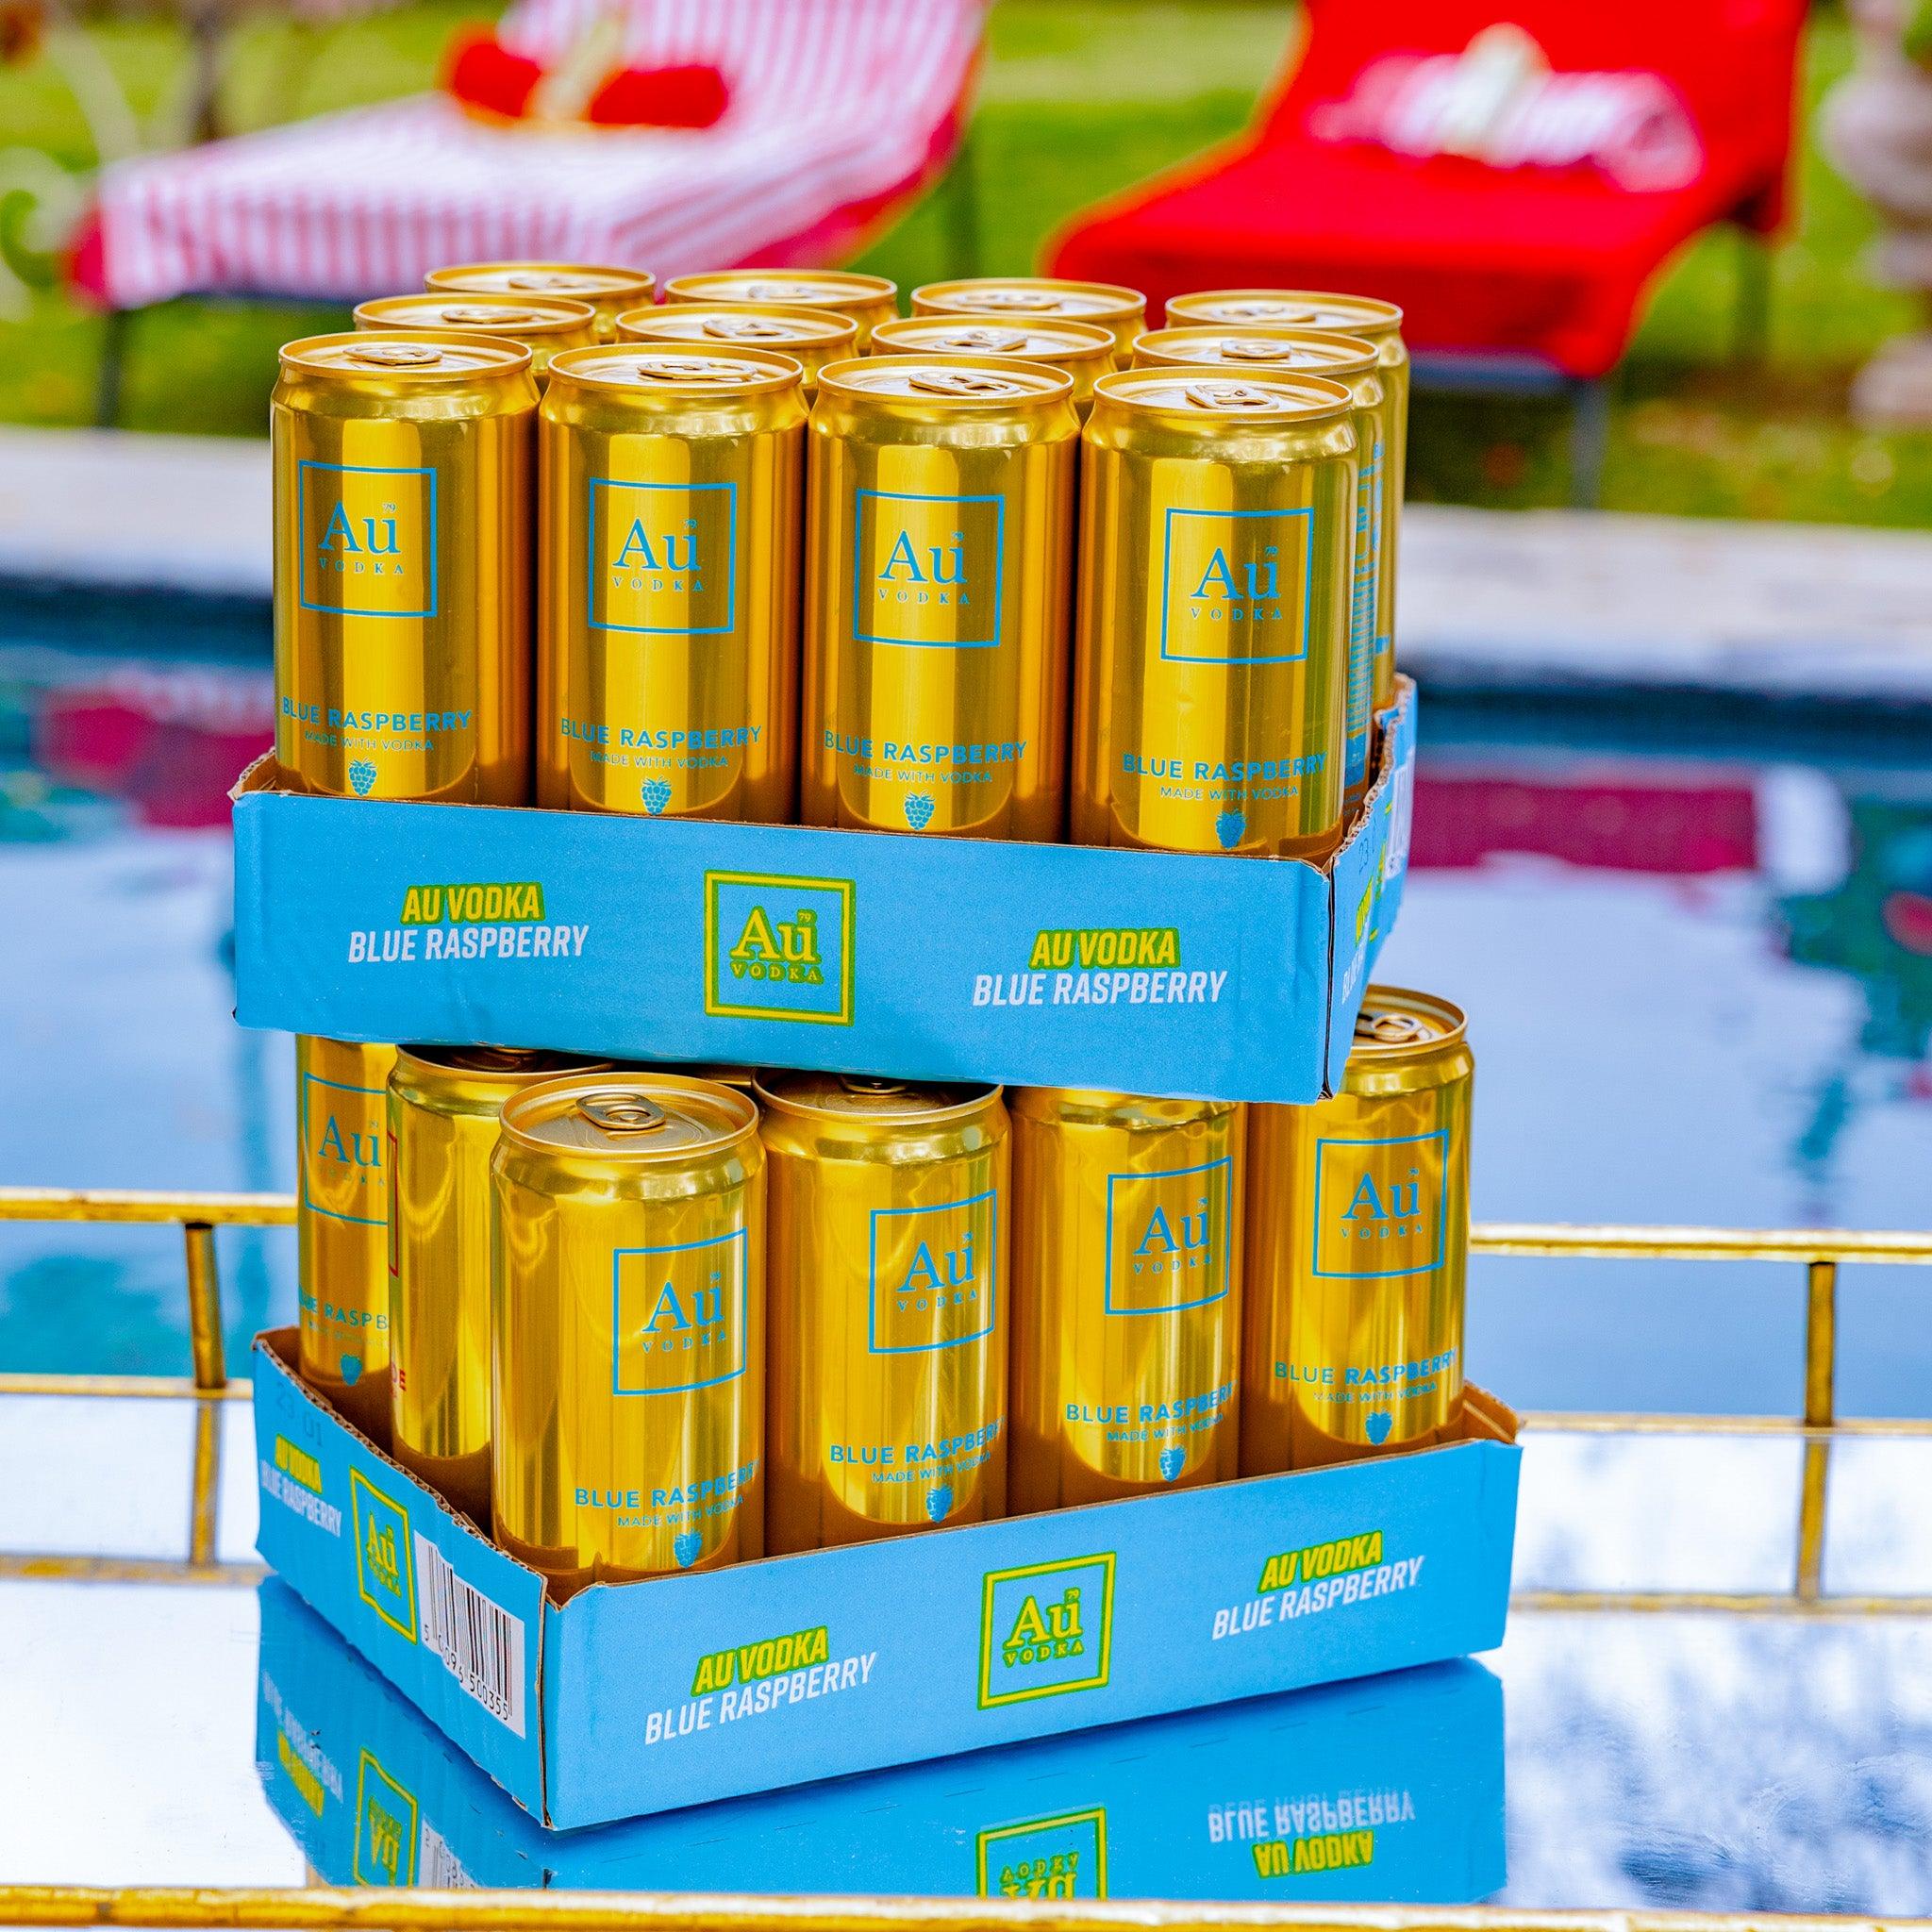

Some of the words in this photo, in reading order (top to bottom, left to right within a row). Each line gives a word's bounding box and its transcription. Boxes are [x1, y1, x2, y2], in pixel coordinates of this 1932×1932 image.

[319, 501, 402, 555] Au
[612, 516, 701, 572] Au
[319, 558, 404, 574] VODKA
[878, 529, 967, 584] Au
[613, 576, 705, 591] VODKA
[1190, 547, 1281, 600] Au
[878, 589, 970, 605] VODKA
[1191, 608, 1283, 621] VODKA
[282, 696, 320, 724] BLUE
[328, 709, 472, 732] RASPBERRY
[305, 730, 337, 747] MADE
[341, 737, 376, 749] WITH
[381, 739, 434, 751] VODKA
[560, 718, 609, 744] BLUE
[621, 725, 762, 749] RASPBERRY
[824, 730, 873, 758] BLUE
[883, 741, 1027, 764] RASPBERRY
[591, 751, 628, 766] MADE
[634, 755, 672, 768] WITH
[677, 756, 728, 769] VODKA
[853, 764, 892, 780] MADE
[898, 770, 935, 782] WITH
[941, 771, 992, 784] VODKA
[1122, 754, 1183, 780] BLUE
[1194, 752, 1327, 782] RASPBERRY
[1159, 785, 1203, 800] MADE
[1209, 786, 1246, 800] WITH
[1252, 785, 1299, 800] VODKA
[402, 887, 441, 924] AU
[447, 884, 542, 923] VODKA
[348, 930, 418, 962] BLUE
[425, 924, 589, 960] RASPBERRY
[730, 908, 820, 962] Au
[1029, 931, 1074, 968] AU
[1078, 928, 1179, 968] VODKA
[731, 962, 822, 983] VODKA
[973, 974, 1047, 1007] BLUE
[1053, 971, 1227, 1005] RASPBERRY
[319, 1115, 381, 1168] Au
[1341, 1172, 1421, 1221] Au
[1133, 1205, 1211, 1255] Au
[1341, 1224, 1424, 1240] VODKA
[896, 1241, 974, 1291] Au
[1133, 1257, 1212, 1275] VODKA
[324, 1304, 388, 1329] RASPB
[641, 1281, 724, 1333] Au
[897, 1290, 977, 1312] VODKA
[642, 1330, 727, 1354] VODKA
[1274, 1361, 1334, 1385] BLUE
[1065, 1404, 1128, 1424] BLUE
[1140, 1379, 1238, 1424] RASPBERR
[1359, 1389, 1393, 1403] WITH
[830, 1444, 894, 1464] BLUE
[905, 1415, 1006, 1463] RASPBER
[1108, 1430, 1149, 1442] MADE
[1153, 1424, 1187, 1440] WITH
[872, 1471, 914, 1483] MADE
[919, 1464, 954, 1481] WITH
[575, 1489, 640, 1508] BLUE
[618, 1516, 663, 1527] MADE
[666, 1509, 702, 1525] WITH
[1259, 1553, 1298, 1592] AU
[1302, 1531, 1382, 1581] VODKA
[1212, 1595, 1275, 1641] BLUE
[1279, 1556, 1424, 1622] RASPBERRY
[1004, 1596, 1083, 1648] Au
[693, 1653, 734, 1695] AU
[739, 1627, 827, 1681] VODKA
[1005, 1640, 1083, 1668] VODKA
[645, 1697, 713, 1745] BLUE
[720, 1652, 876, 1724] RASPBERRY
